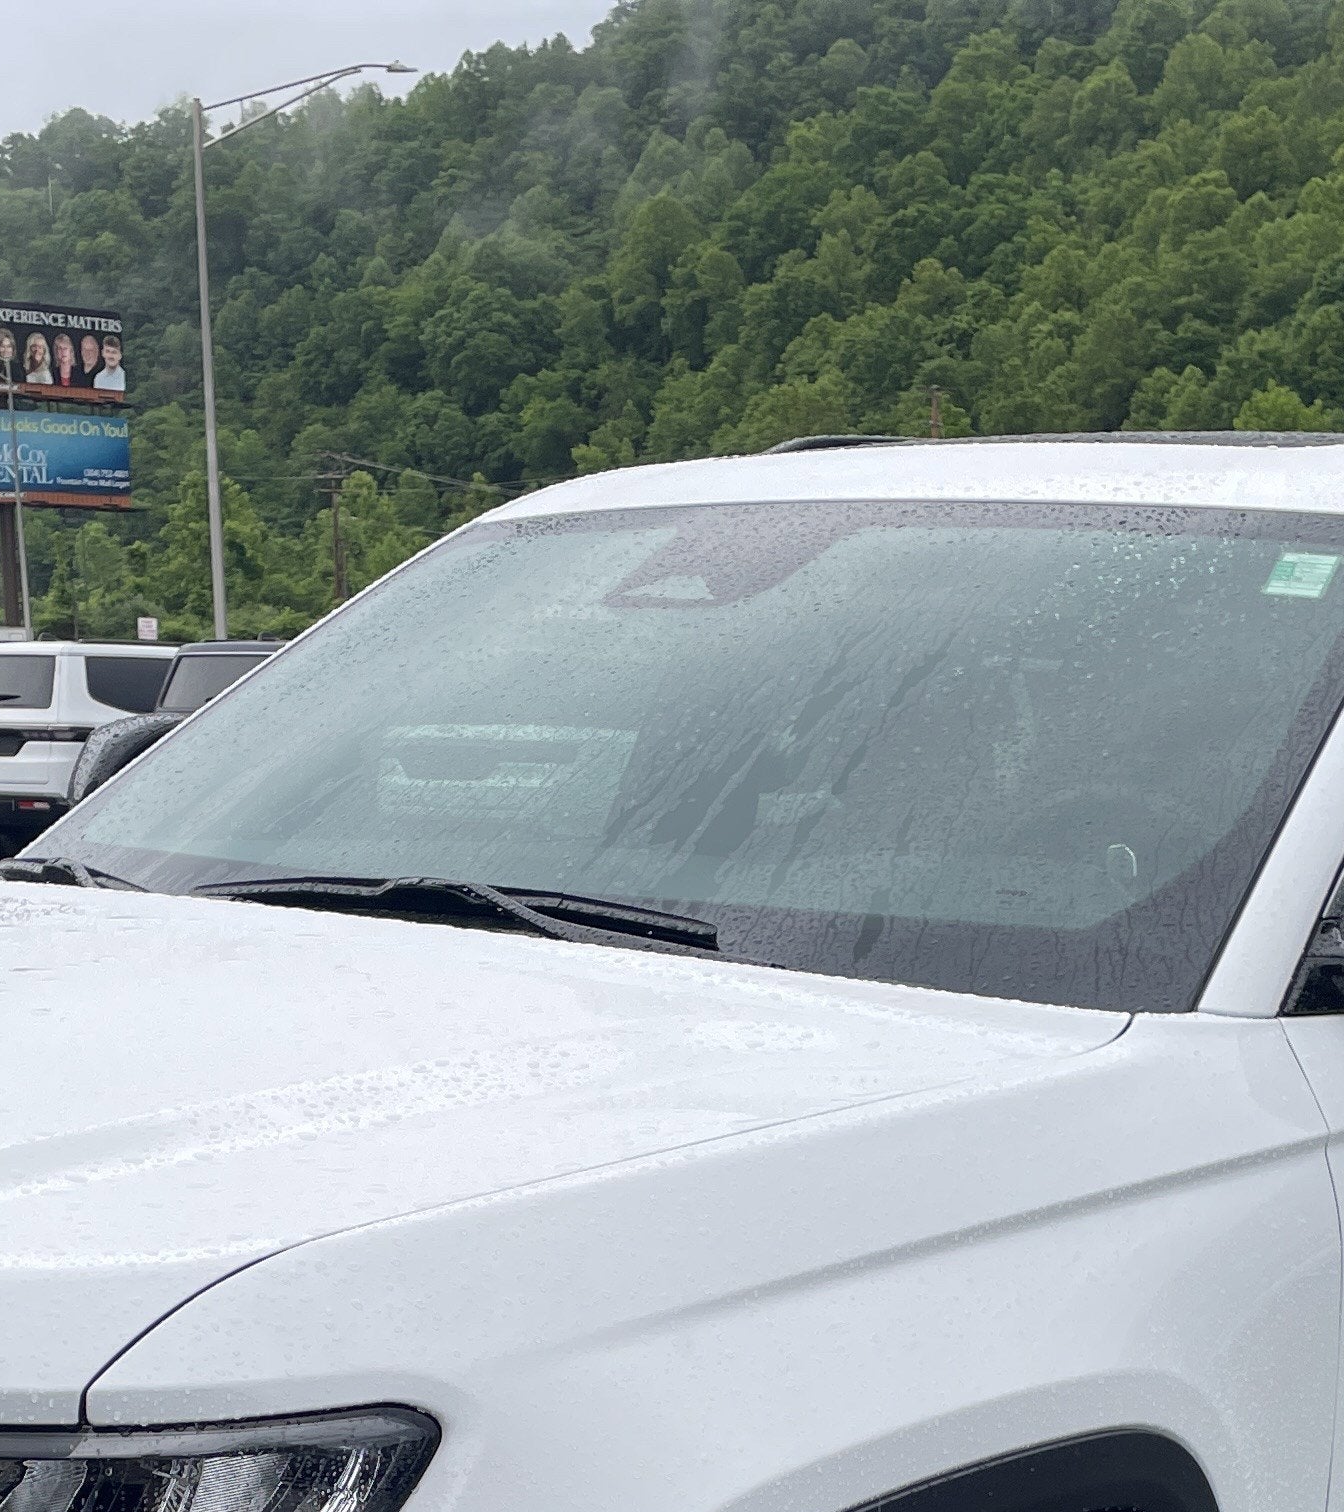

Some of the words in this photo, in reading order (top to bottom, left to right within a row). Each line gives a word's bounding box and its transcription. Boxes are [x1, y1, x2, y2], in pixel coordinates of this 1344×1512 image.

[67, 315, 122, 333] MATTERS
[41, 418, 77, 434] Good
[80, 420, 100, 436] On
